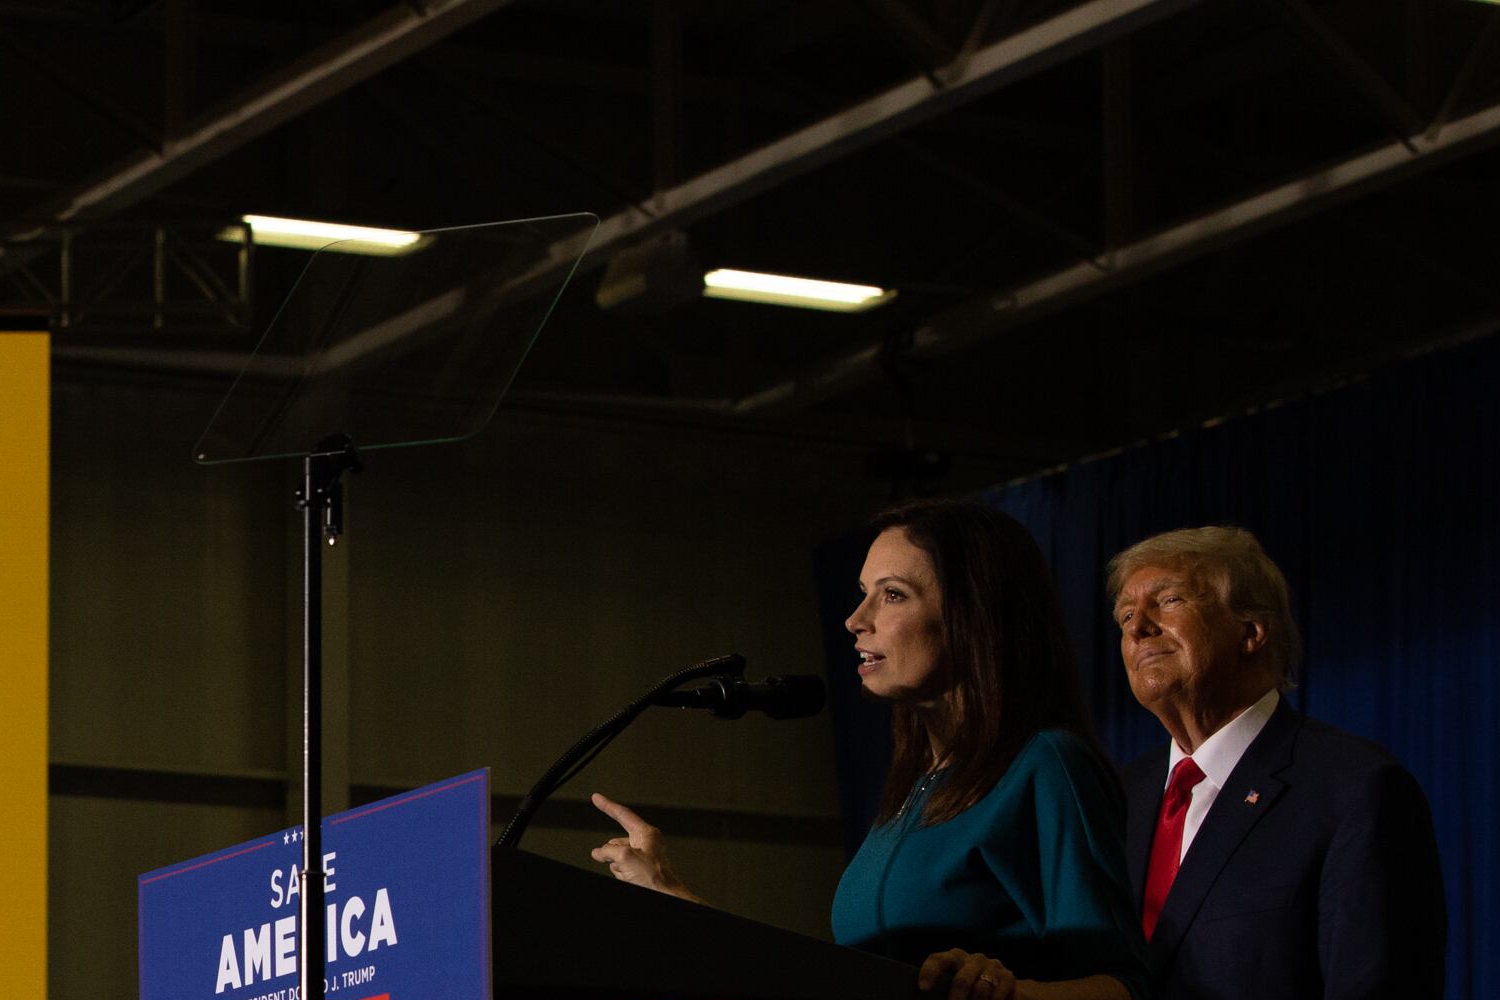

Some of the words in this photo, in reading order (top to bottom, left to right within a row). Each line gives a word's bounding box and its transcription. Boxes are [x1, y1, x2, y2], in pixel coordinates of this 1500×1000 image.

[270, 851, 337, 909] SAE
[215, 887, 398, 995] AMEICA
[331, 978, 340, 992] J.
[342, 965, 376, 988] TRUMP
